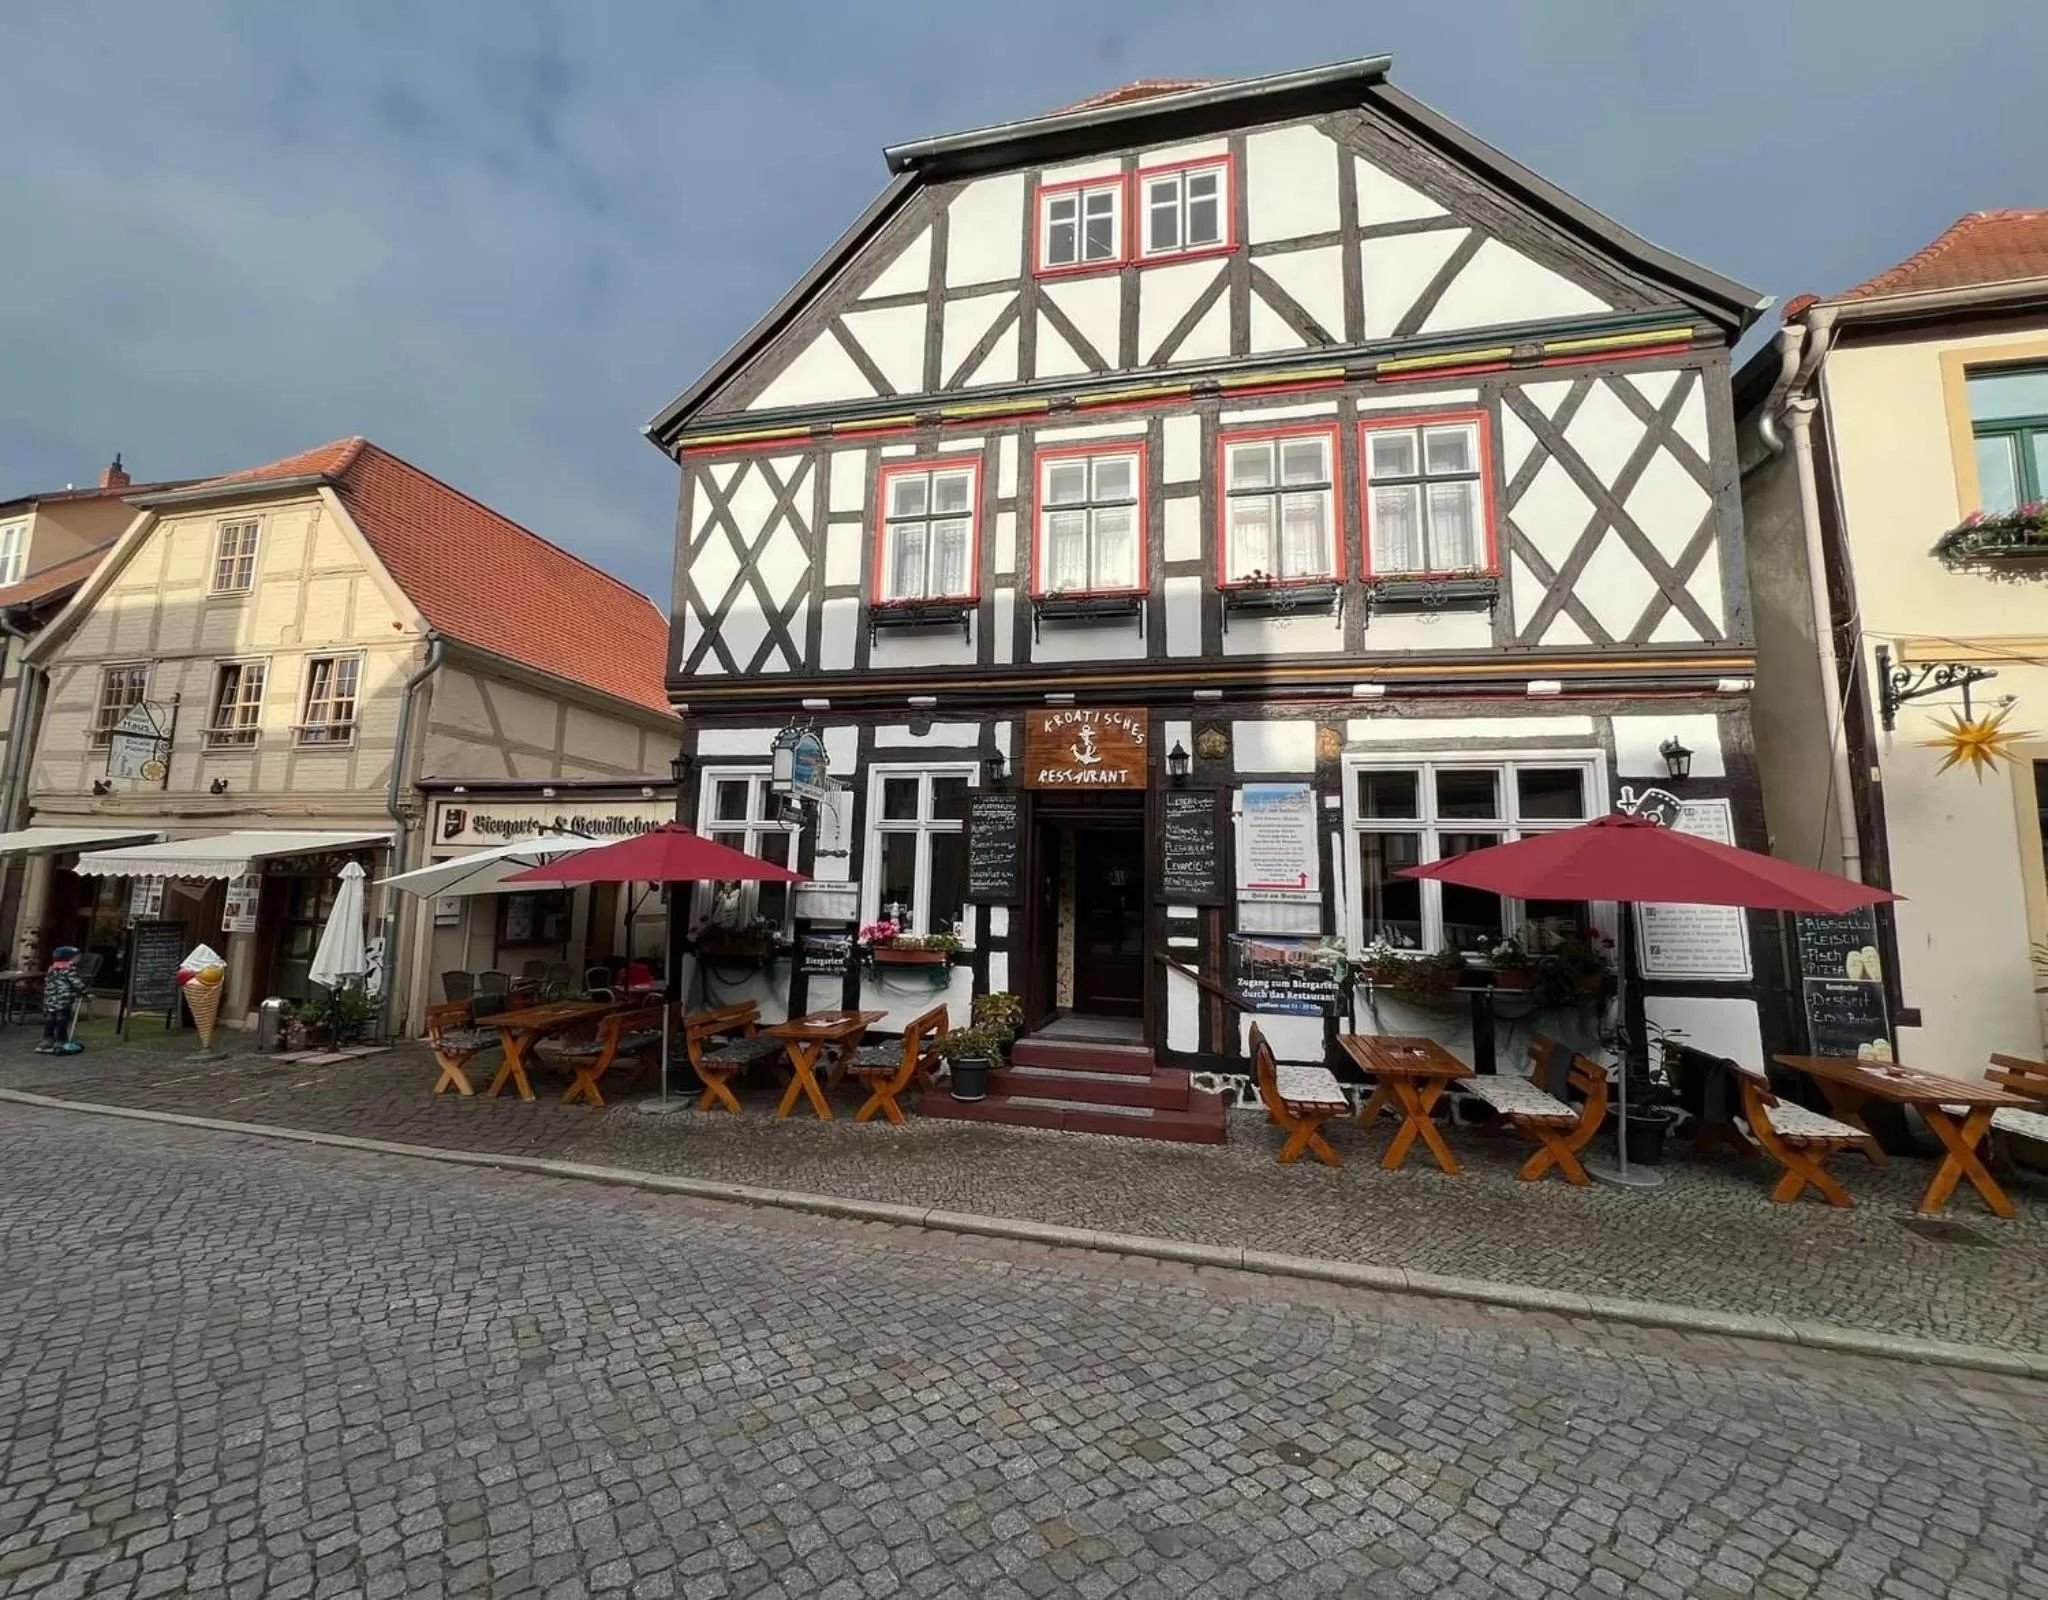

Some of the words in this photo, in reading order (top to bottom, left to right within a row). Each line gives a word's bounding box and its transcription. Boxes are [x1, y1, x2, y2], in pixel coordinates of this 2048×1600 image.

[1044, 710, 1145, 744] KROATISCHES
[1038, 769, 1128, 784] RESTAURANT
[1237, 977, 1269, 989] Zugang
[1271, 980, 1290, 988] zum
[1292, 980, 1339, 991] Biergarten
[1242, 988, 1267, 998] durch
[1269, 990, 1285, 999] das
[1287, 991, 1335, 1001] Restaurant
